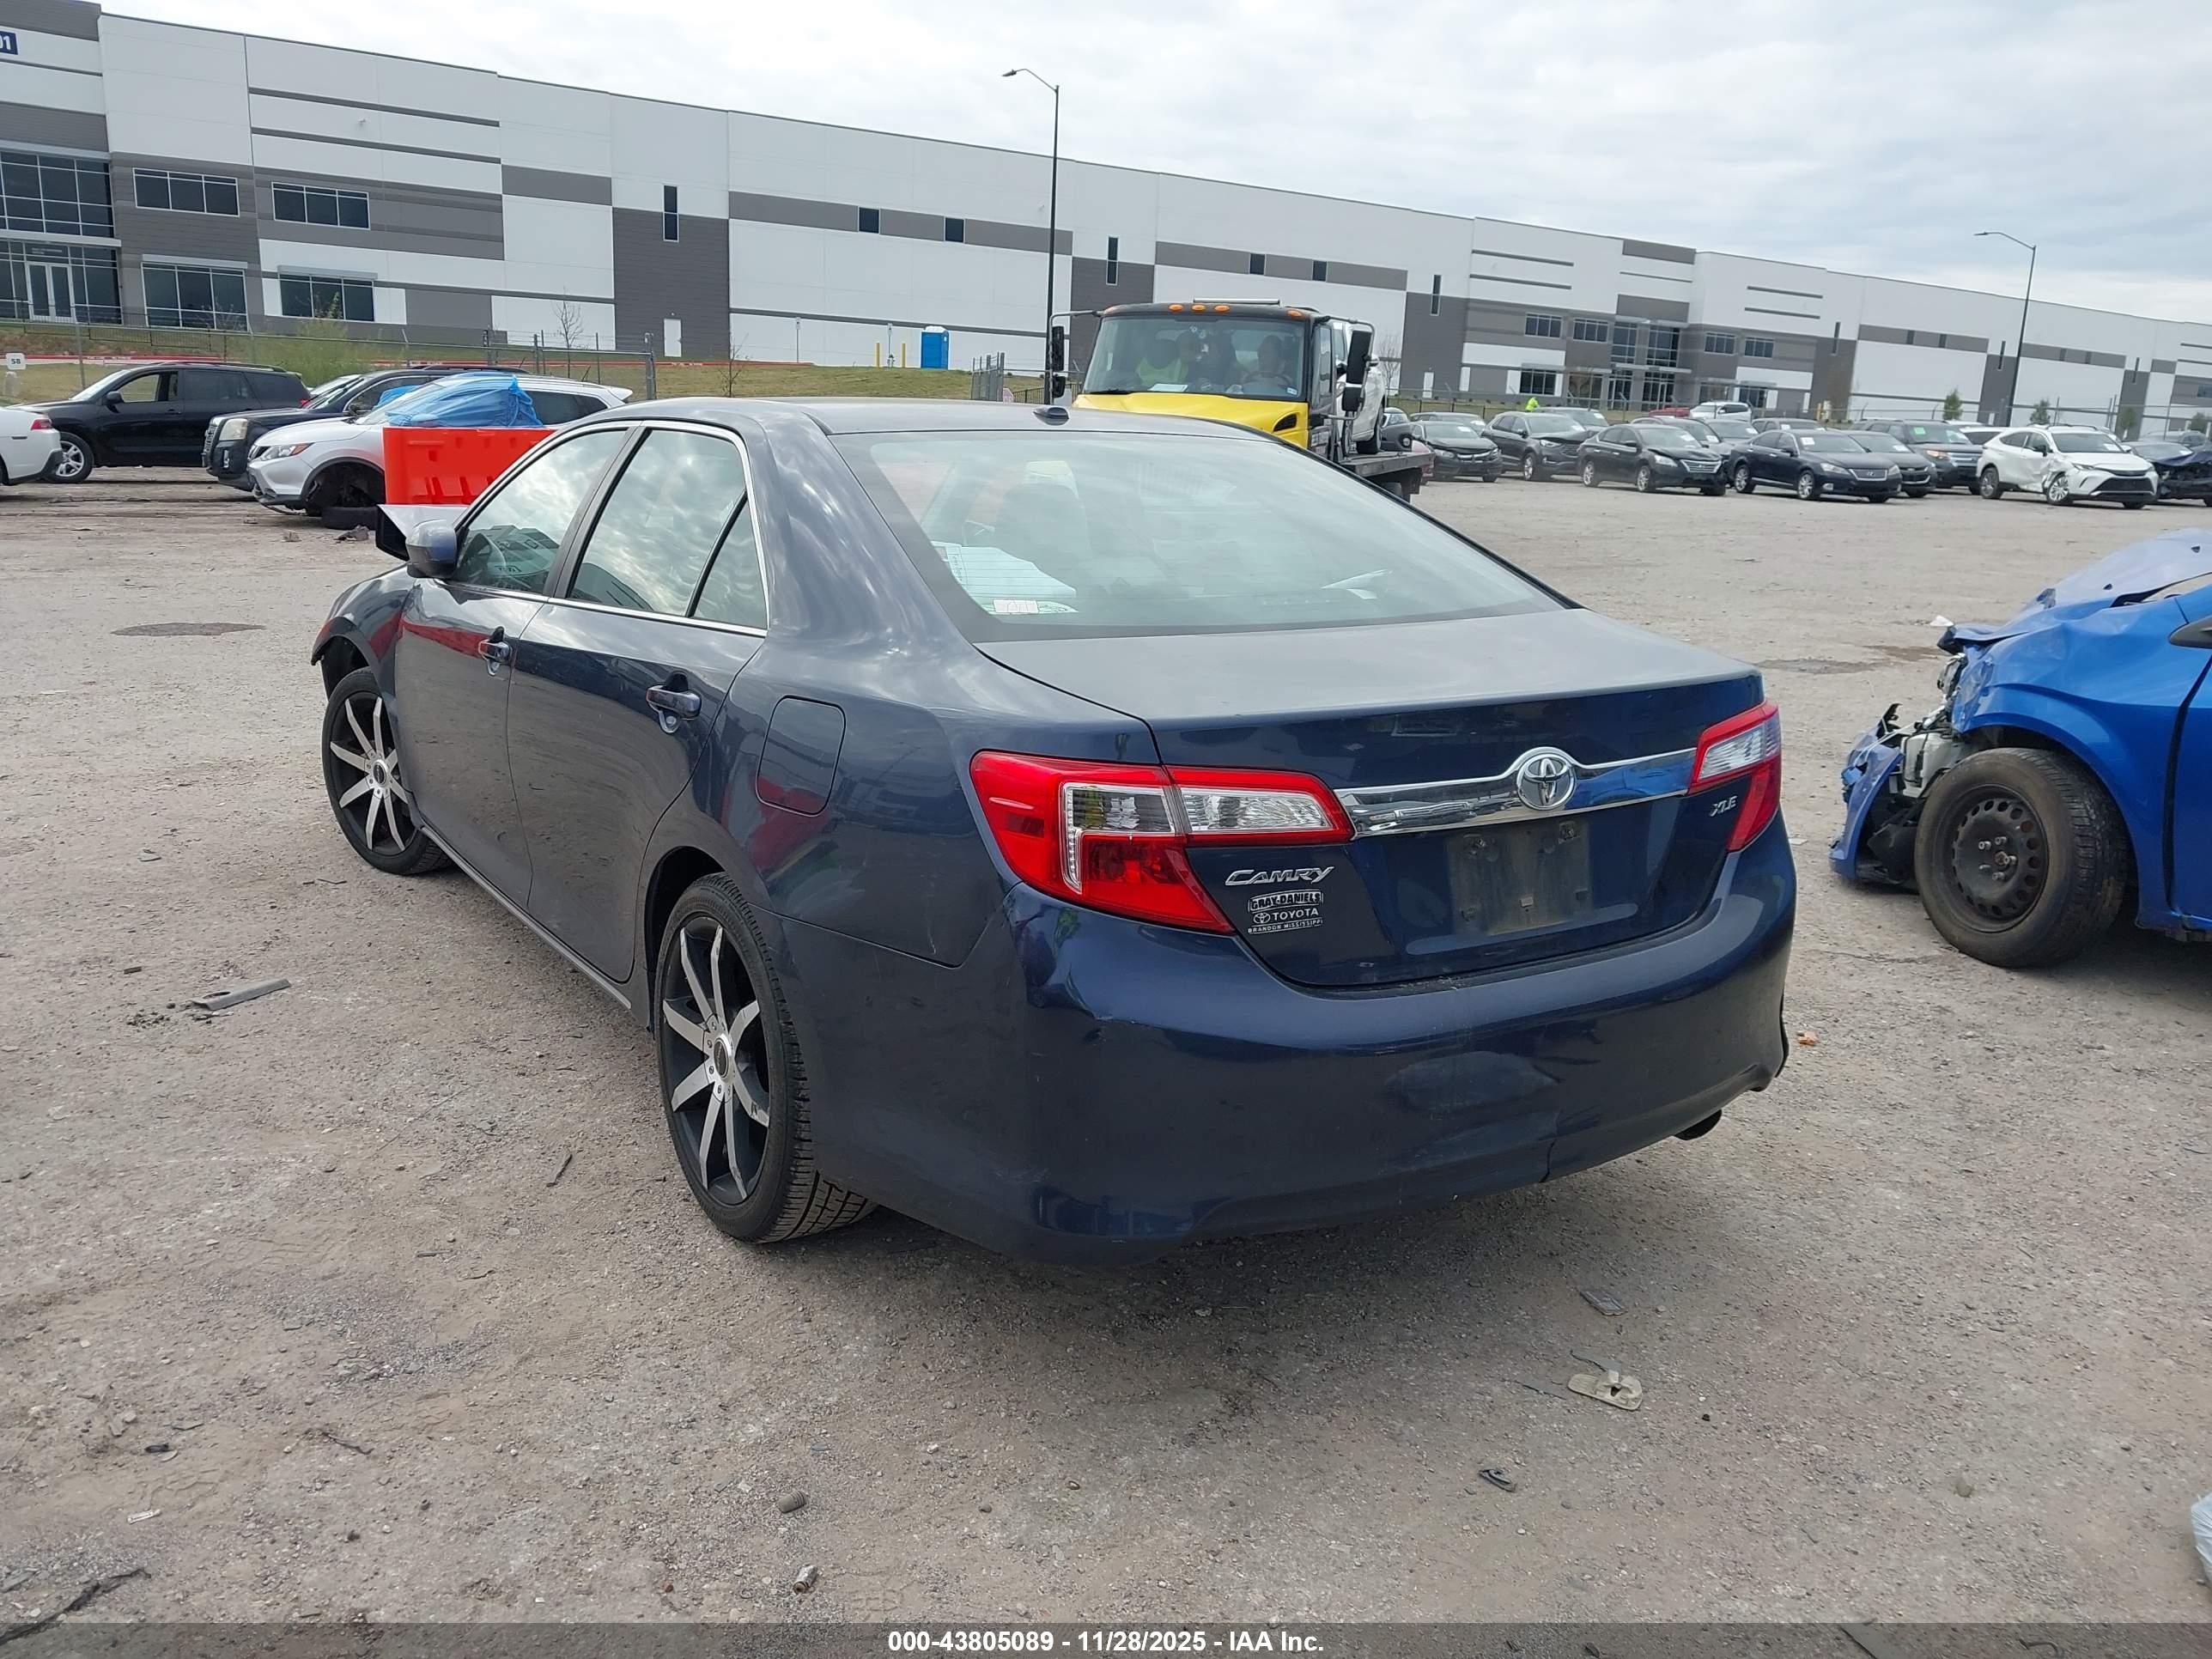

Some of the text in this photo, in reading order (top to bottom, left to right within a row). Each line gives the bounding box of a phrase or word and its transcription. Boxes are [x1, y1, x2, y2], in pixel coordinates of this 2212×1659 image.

[1710, 795, 1738, 817] XLE
[1225, 866, 1334, 885] CAMRY
[1273, 908, 1319, 921] TOYOTA
[1248, 919, 1323, 933] BRANDON MISSISSIPPI
